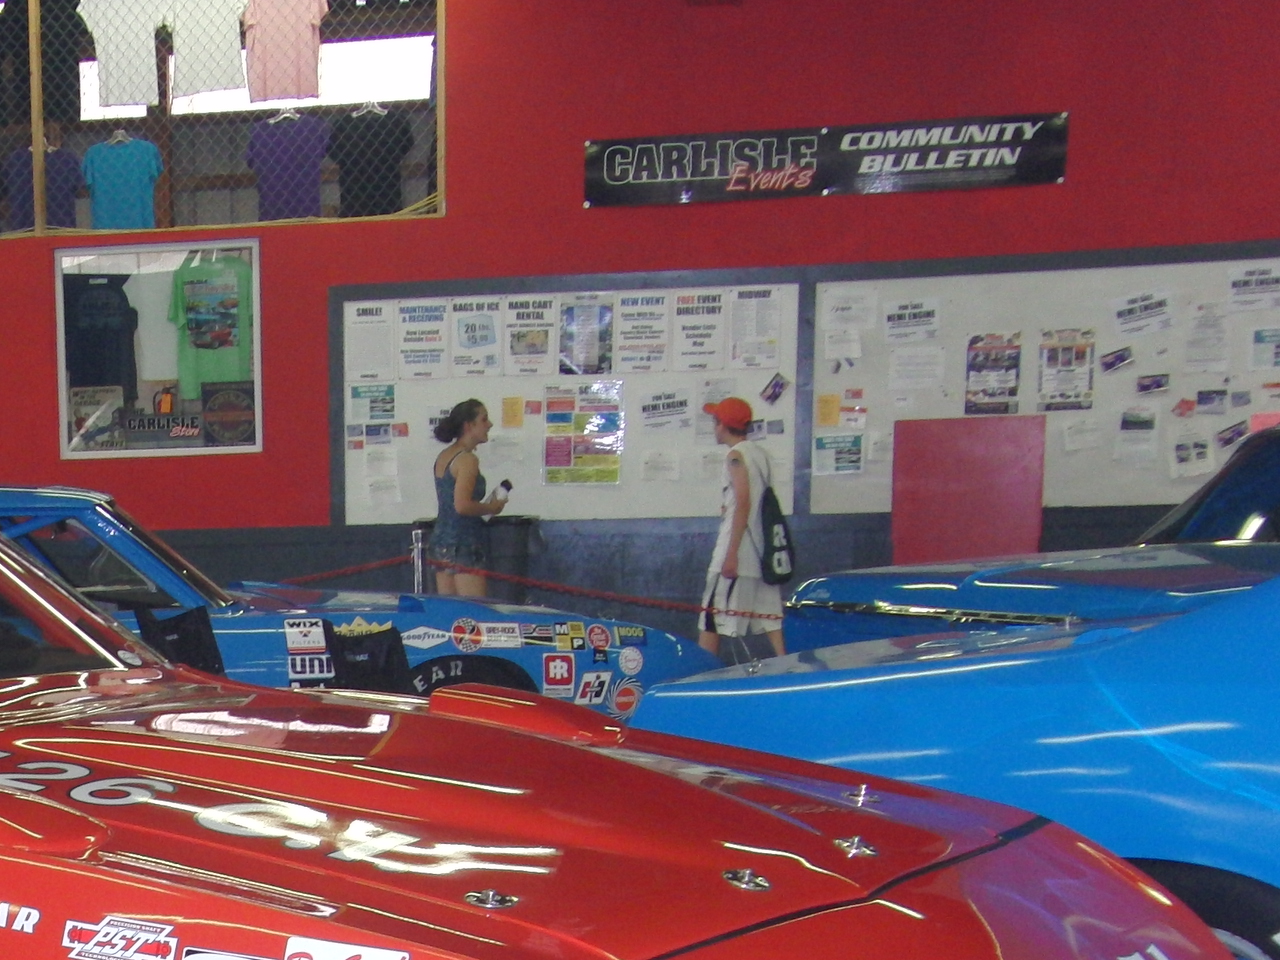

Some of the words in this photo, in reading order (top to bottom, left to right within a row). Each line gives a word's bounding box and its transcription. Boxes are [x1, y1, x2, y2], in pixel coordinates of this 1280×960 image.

[840, 121, 1044, 151] COMMUNITY
[604, 135, 818, 184] CARLISLE
[858, 147, 1024, 175] BULLETIN
[726, 162, 817, 191] Events
[641, 296, 665, 306] EVENT
[737, 290, 772, 299] MIDWAY
[453, 303, 474, 312] BAGS
[475, 303, 486, 311] OF
[487, 302, 500, 311] ICE
[677, 305, 722, 316] DIRECTORY
[464, 323, 476, 333] 20
[127, 416, 199, 431] CARLISLE
[286, 620, 320, 628] WIX
[81, 926, 159, 959] PST
